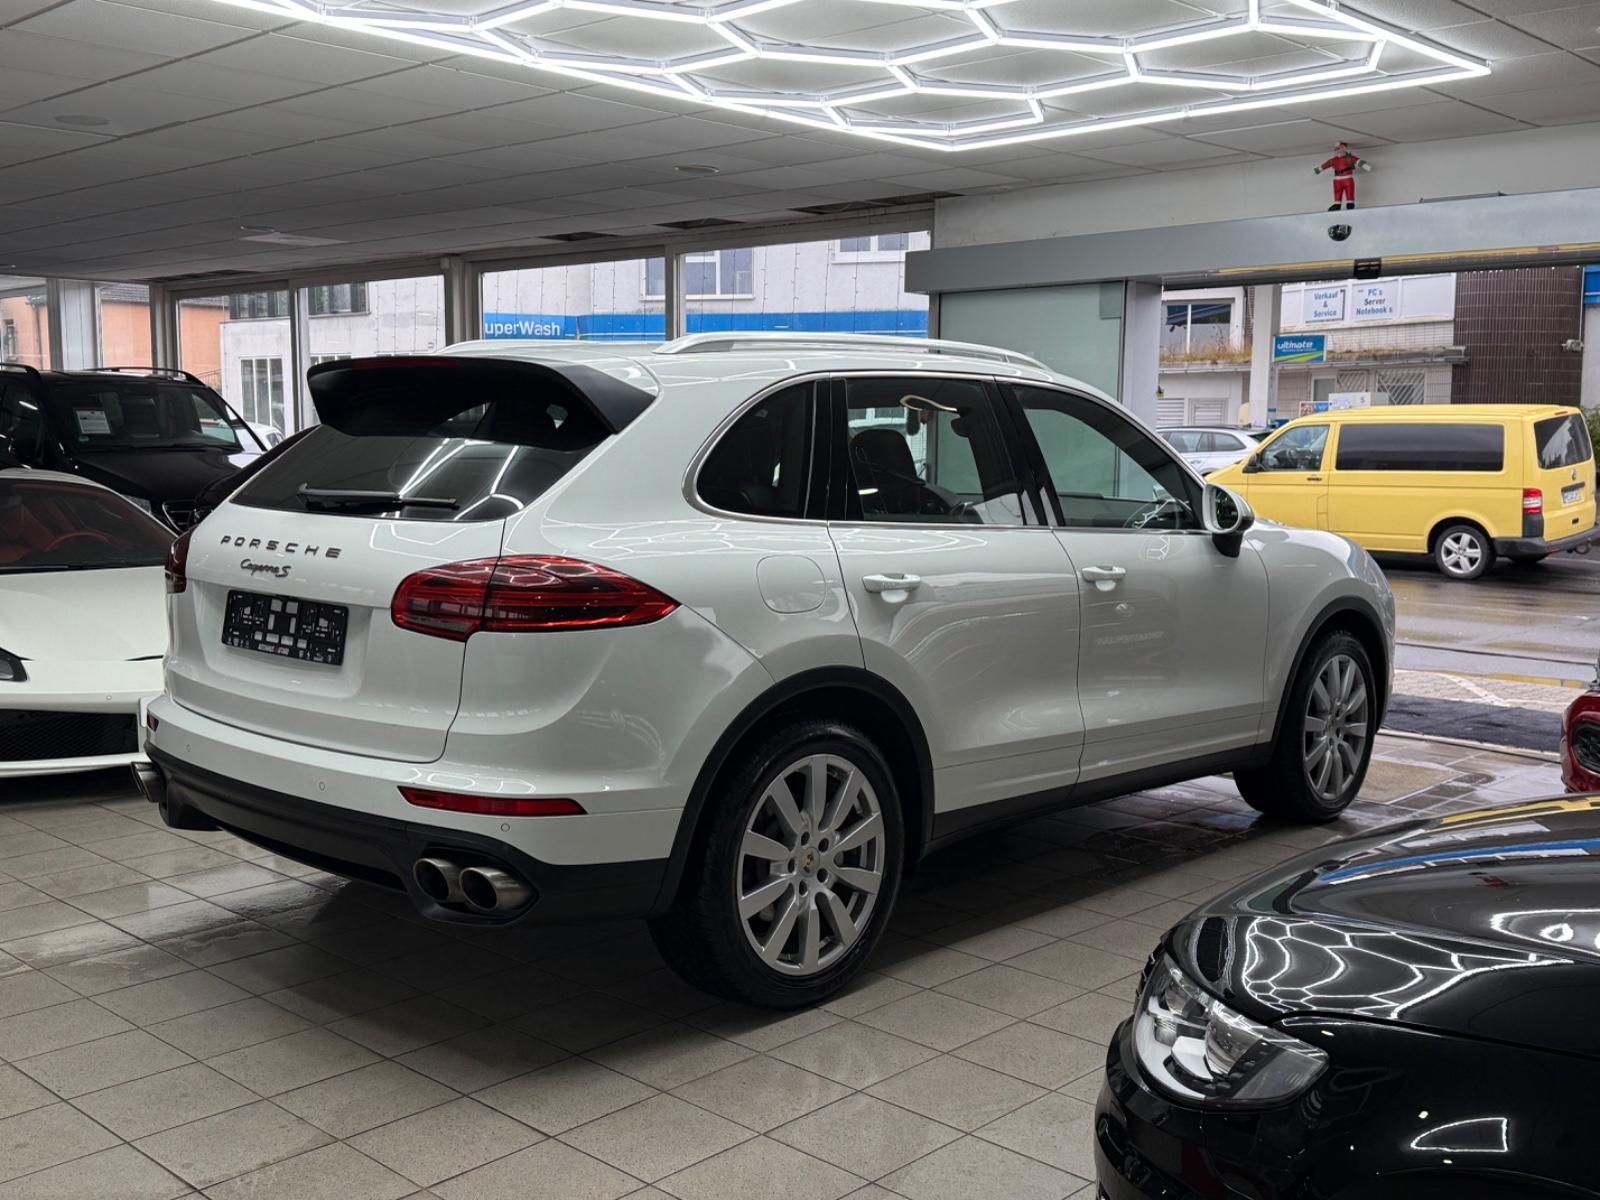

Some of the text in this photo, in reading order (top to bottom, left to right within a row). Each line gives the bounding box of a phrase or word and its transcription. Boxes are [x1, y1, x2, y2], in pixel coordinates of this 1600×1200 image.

[1314, 291, 1338, 300] Verkauf
[1364, 298, 1386, 306] Server
[1313, 309, 1337, 318] Service
[220, 535, 342, 558] PORSCHE
[240, 558, 291, 578] Cayenne S
